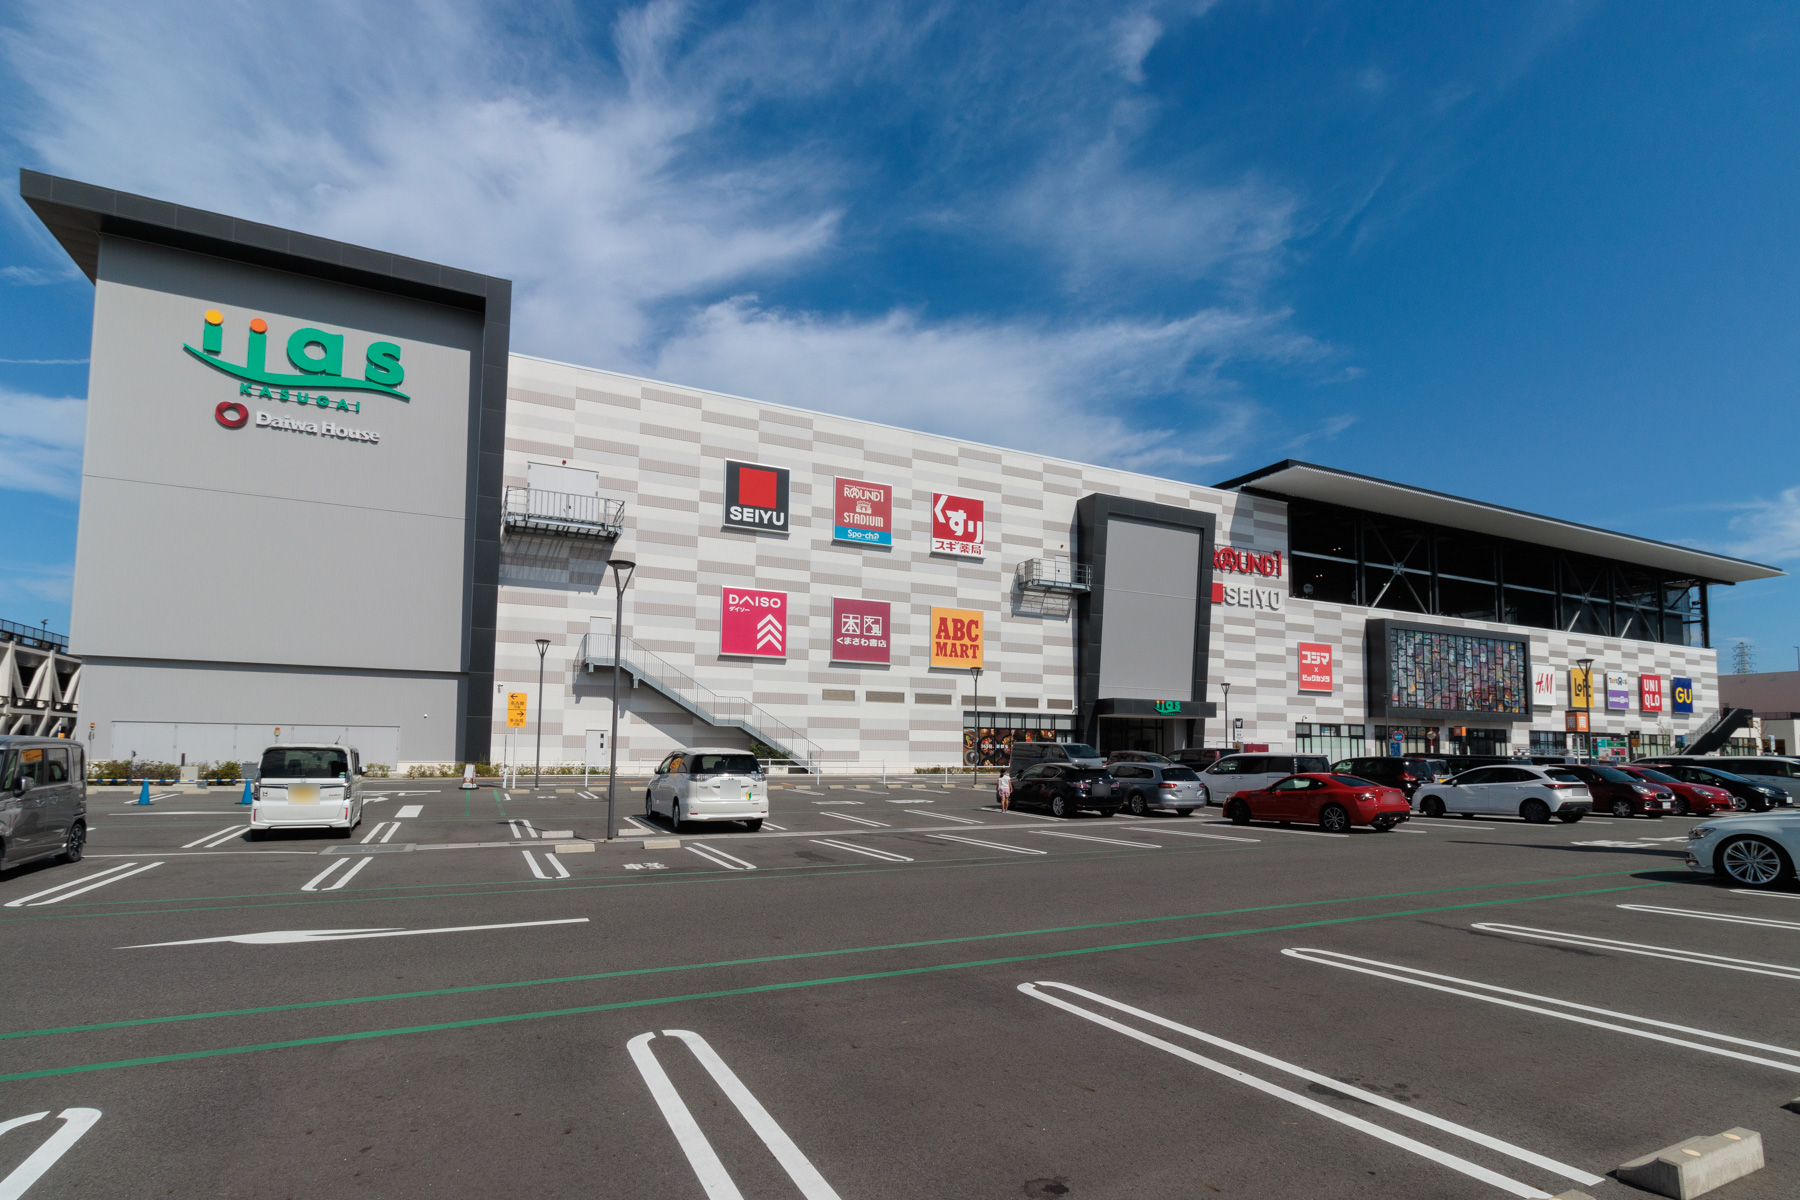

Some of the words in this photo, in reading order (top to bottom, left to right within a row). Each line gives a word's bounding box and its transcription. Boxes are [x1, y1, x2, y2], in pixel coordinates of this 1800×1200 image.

[240, 382, 361, 412] KASUGAI
[256, 410, 318, 434] Daiwa
[321, 420, 381, 443] House
[843, 487, 884, 503] ROUND1
[729, 505, 785, 526] SEIYU
[843, 512, 884, 528] STADIUM
[934, 494, 983, 544] くすり
[848, 529, 880, 541] Spo-cha
[934, 540, 982, 556] スギ薬局
[729, 594, 781, 608] DAISO
[1224, 585, 1282, 609] SEIYU
[936, 616, 980, 643] ABC
[836, 636, 887, 648] くまざわ書店
[935, 642, 980, 659] MART
[1301, 650, 1330, 665] コジマ
[1302, 674, 1330, 683] ビックカメラ
[1535, 672, 1554, 695] H&M
[1643, 678, 1658, 692] UNI
[1644, 693, 1660, 708] QLO
[1675, 686, 1692, 704] GU
